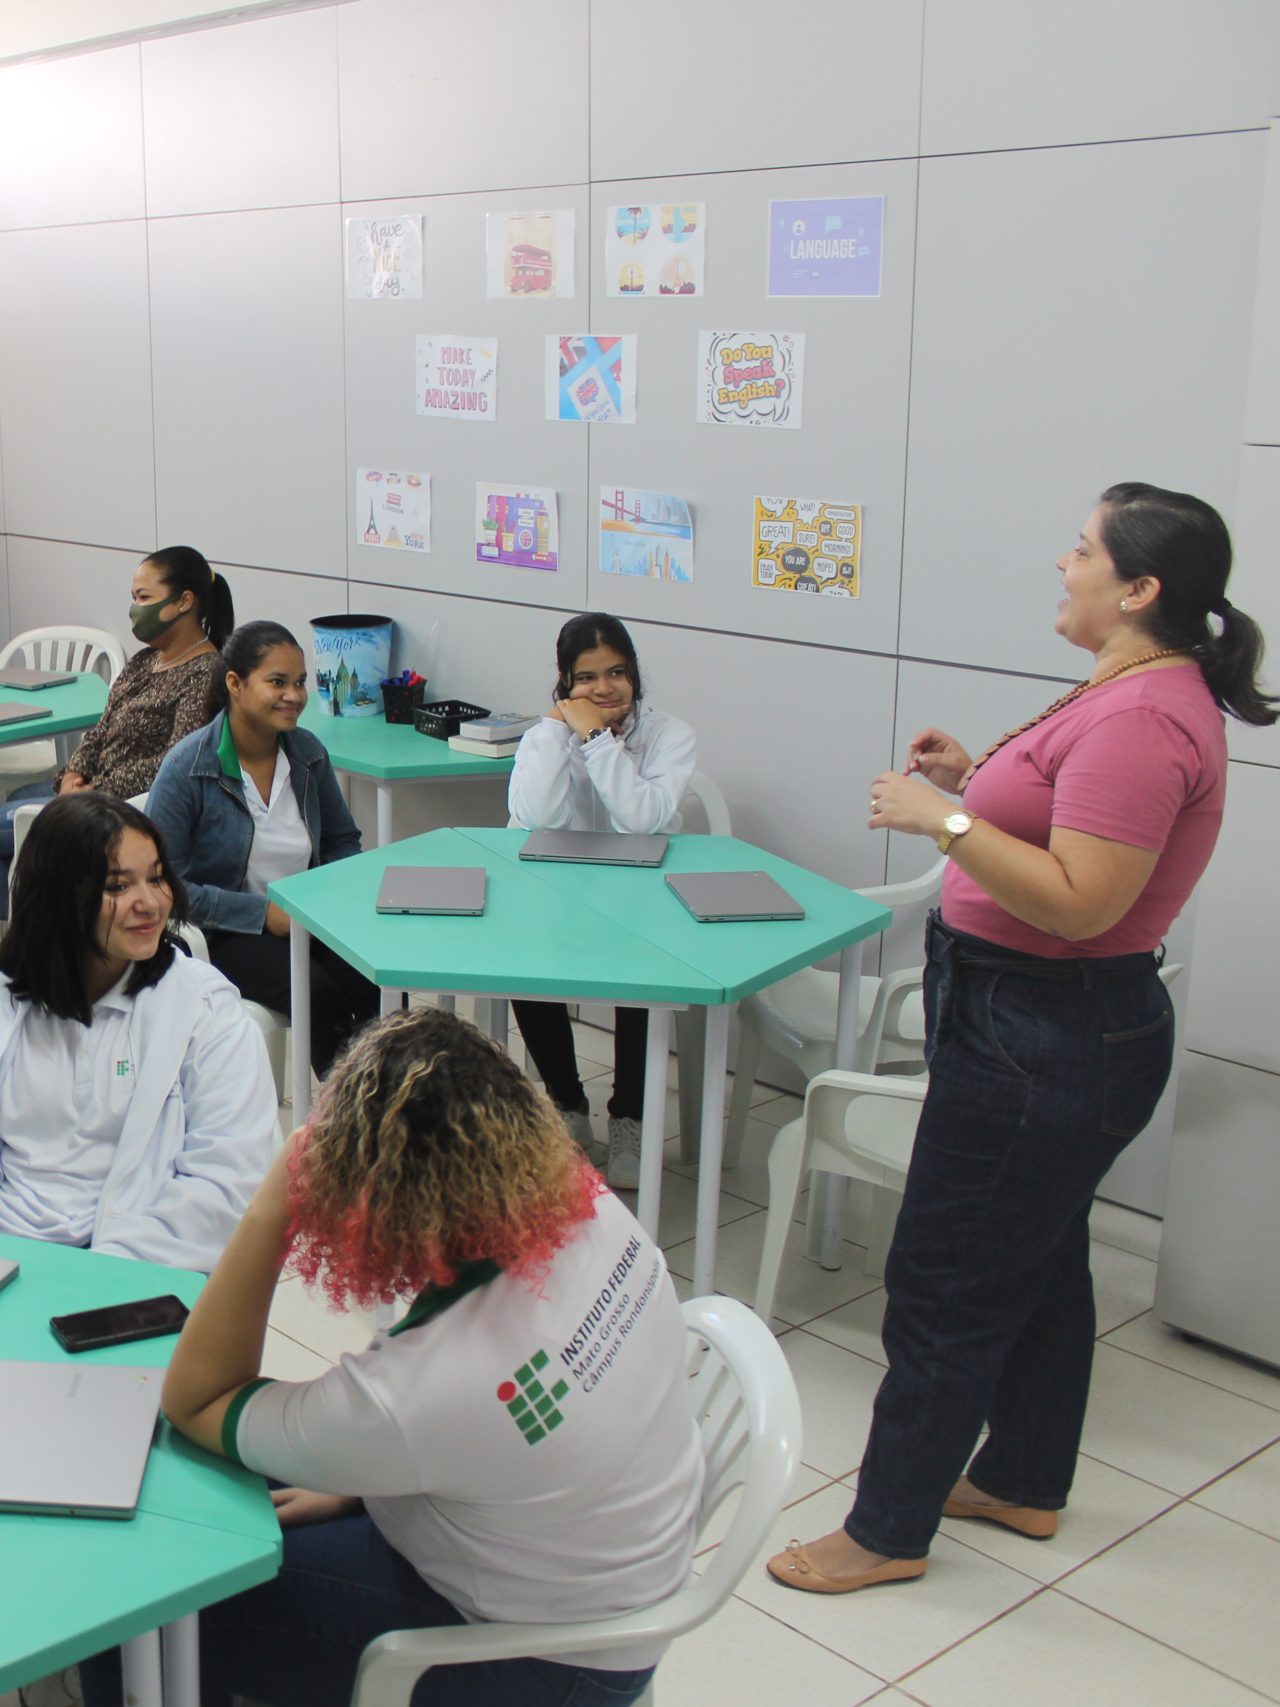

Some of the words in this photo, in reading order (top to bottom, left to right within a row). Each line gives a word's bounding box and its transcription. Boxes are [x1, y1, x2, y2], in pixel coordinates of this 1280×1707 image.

[370, 222, 406, 246] have
[789, 238, 857, 260] LANGUAGE
[440, 346, 473, 366] MAKE
[720, 347, 743, 366] Do
[741, 342, 774, 361] You
[437, 366, 477, 389] TODAY
[723, 359, 777, 389] Speak
[424, 387, 489, 413] AMAZING
[717, 378, 786, 410] English?
[404, 534, 425, 550] YORK
[761, 525, 791, 539] GREAT!
[798, 532, 816, 544] SURE!
[837, 525, 855, 536] GOOD
[559, 1288, 613, 1367] INSTITUTO
[608, 1234, 642, 1293] FEDERAL
[572, 1341, 603, 1381] Mato
[599, 1292, 631, 1342] Grosso
